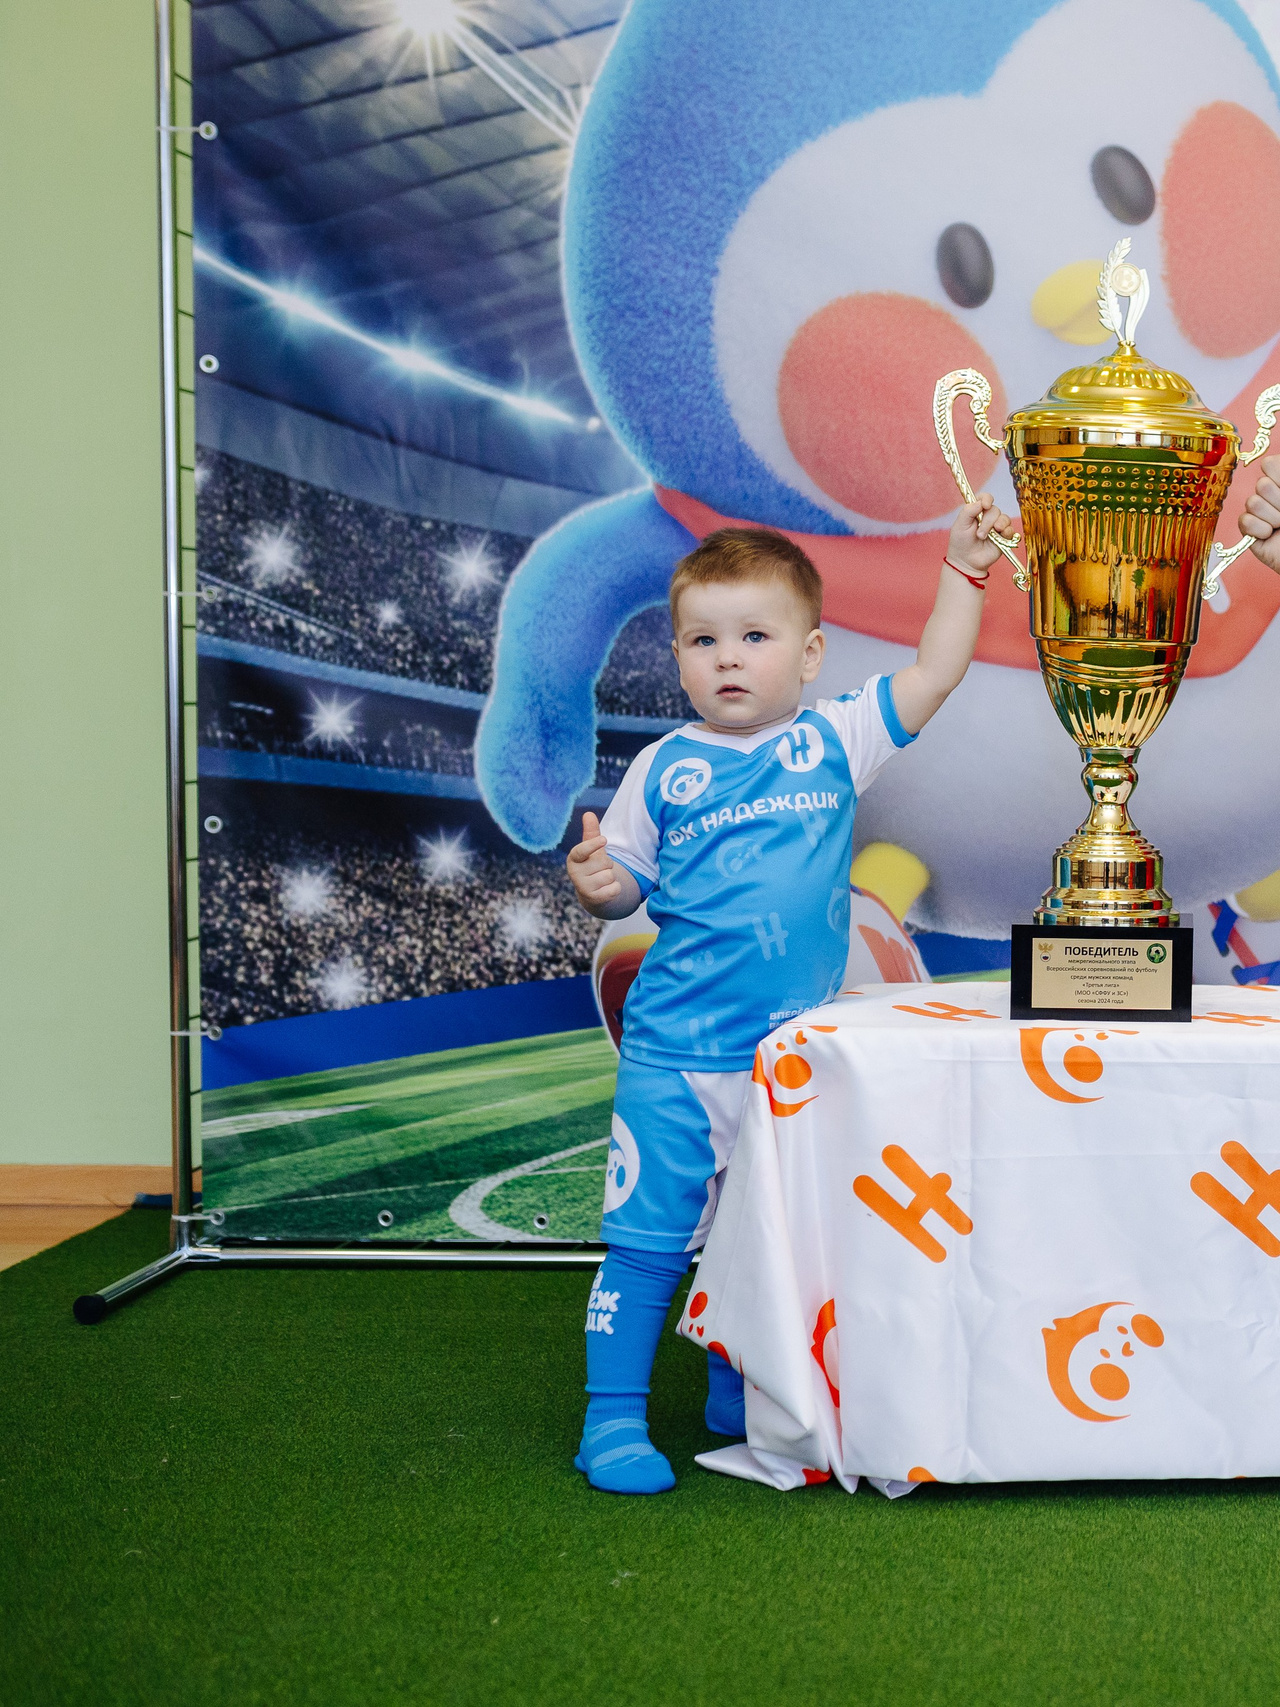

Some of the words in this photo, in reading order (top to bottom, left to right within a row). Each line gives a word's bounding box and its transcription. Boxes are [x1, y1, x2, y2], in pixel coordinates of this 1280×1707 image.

[667, 822, 699, 847] ФК
[701, 792, 839, 833] НАДЕЖДИК
[1064, 946, 1139, 958] ПОБЕДИТЕЛЬ
